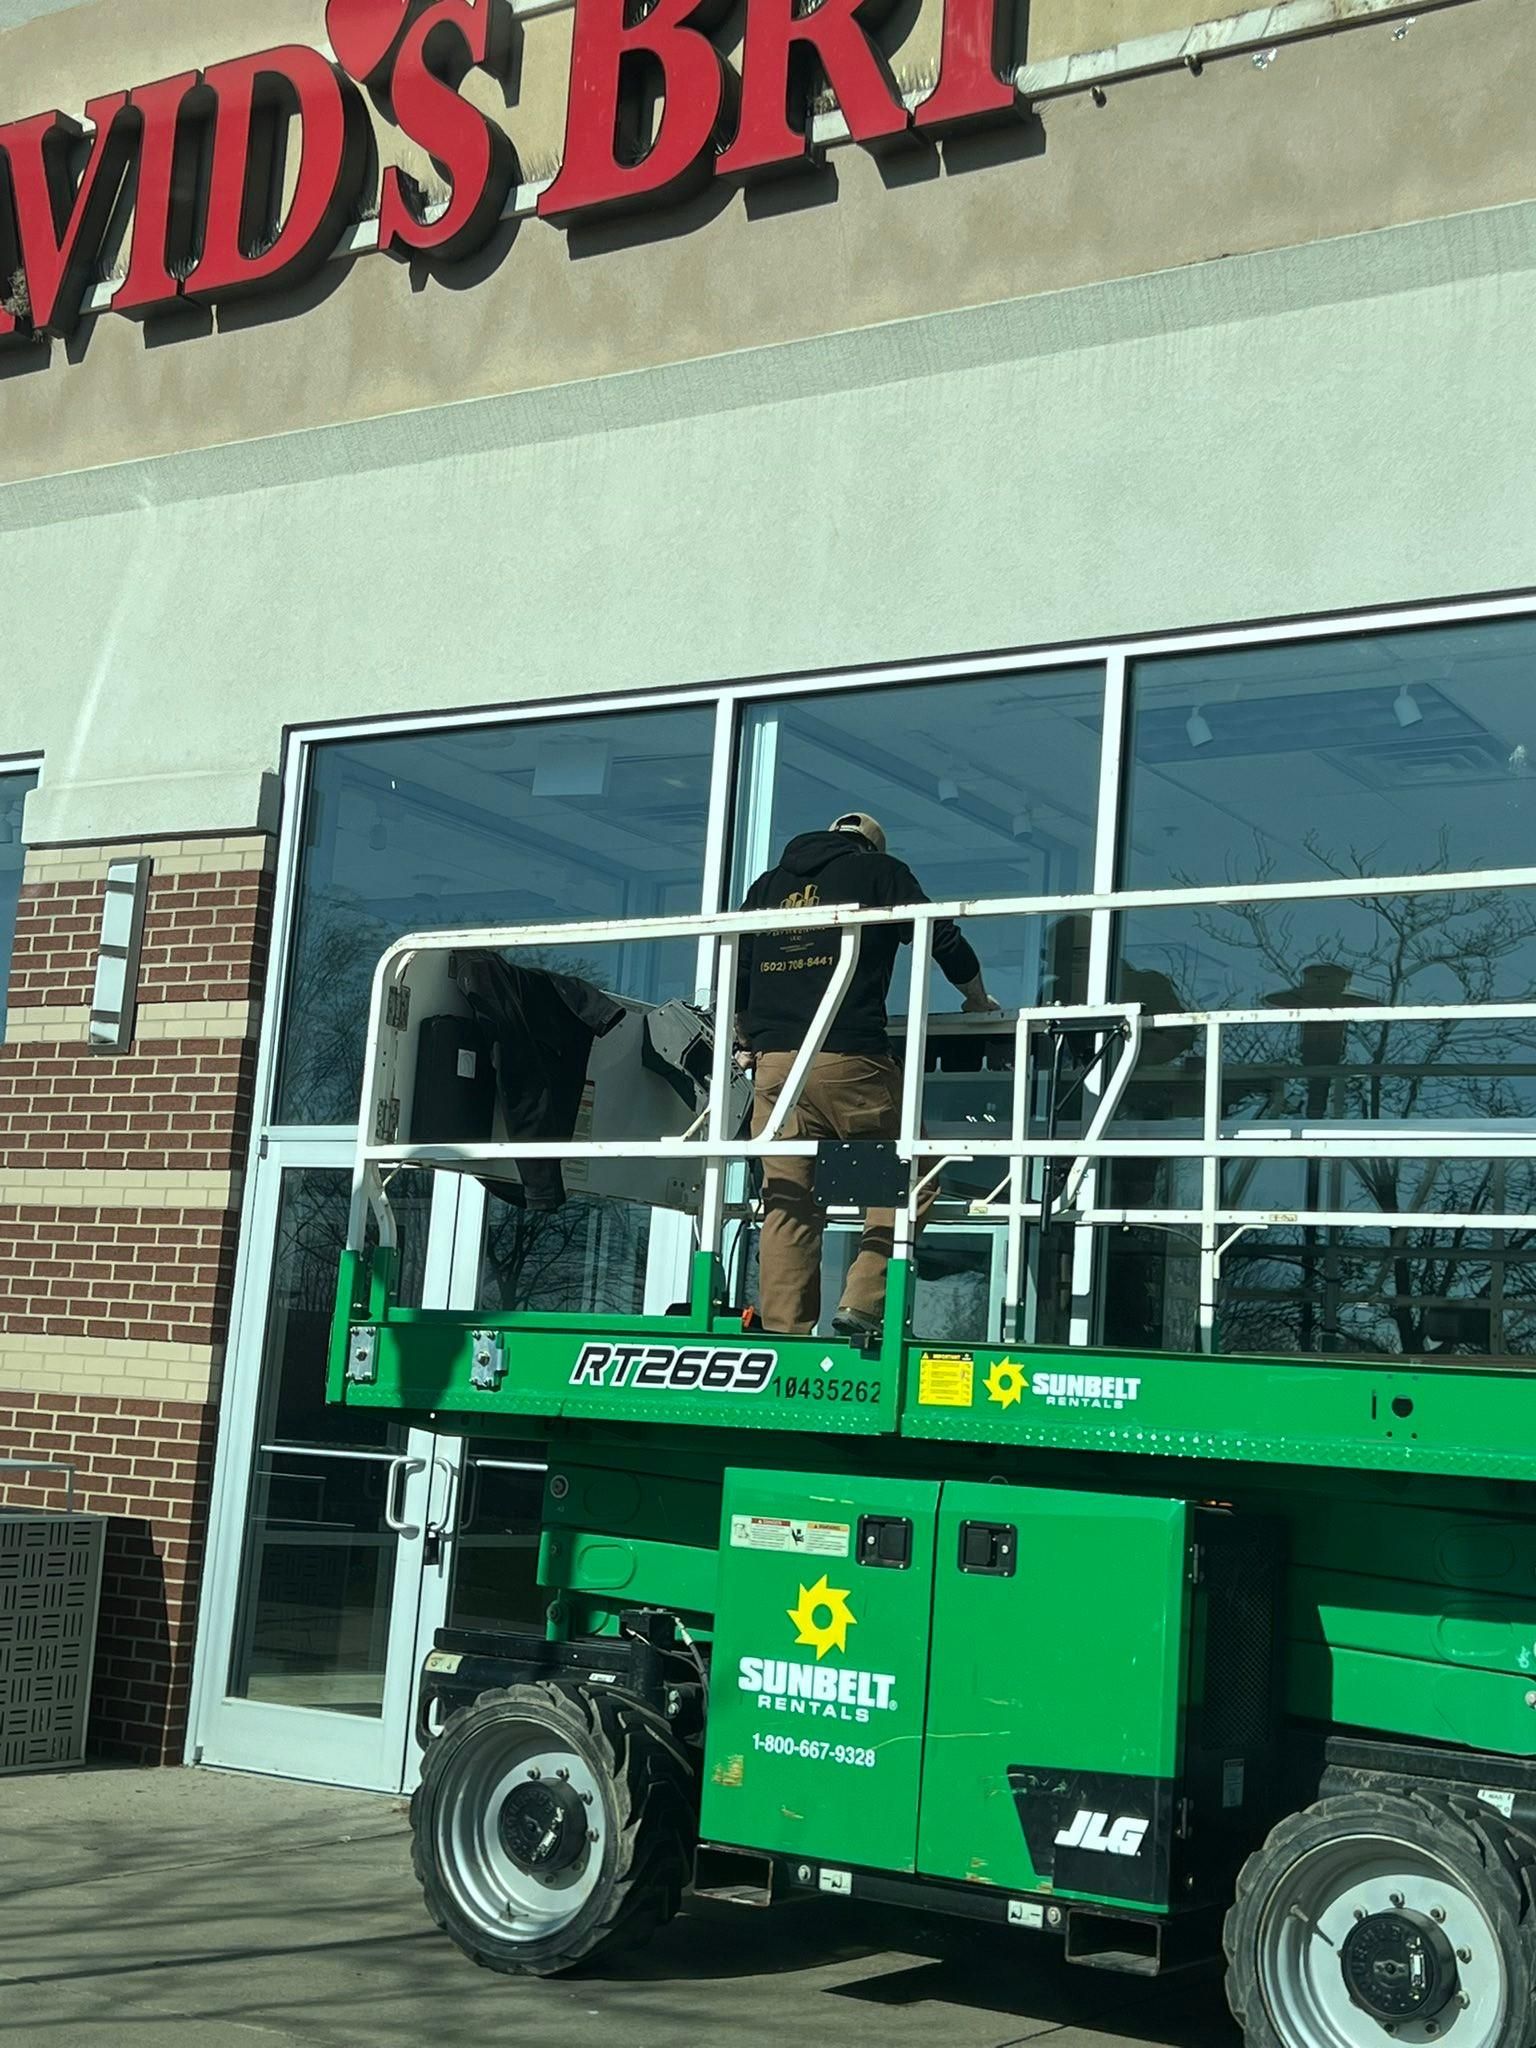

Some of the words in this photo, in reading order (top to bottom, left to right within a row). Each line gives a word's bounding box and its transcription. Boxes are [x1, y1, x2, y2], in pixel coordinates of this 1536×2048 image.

[569, 1342, 778, 1393] RT2669
[772, 1375, 881, 1404] 10435262
[1032, 1373, 1141, 1400] SUNBELT
[1046, 1396, 1124, 1409] RENTALS
[757, 1694, 870, 1723] RENTALS
[752, 1732, 876, 1768] 1-800-667-9328
[1054, 1809, 1150, 1857] JLG
